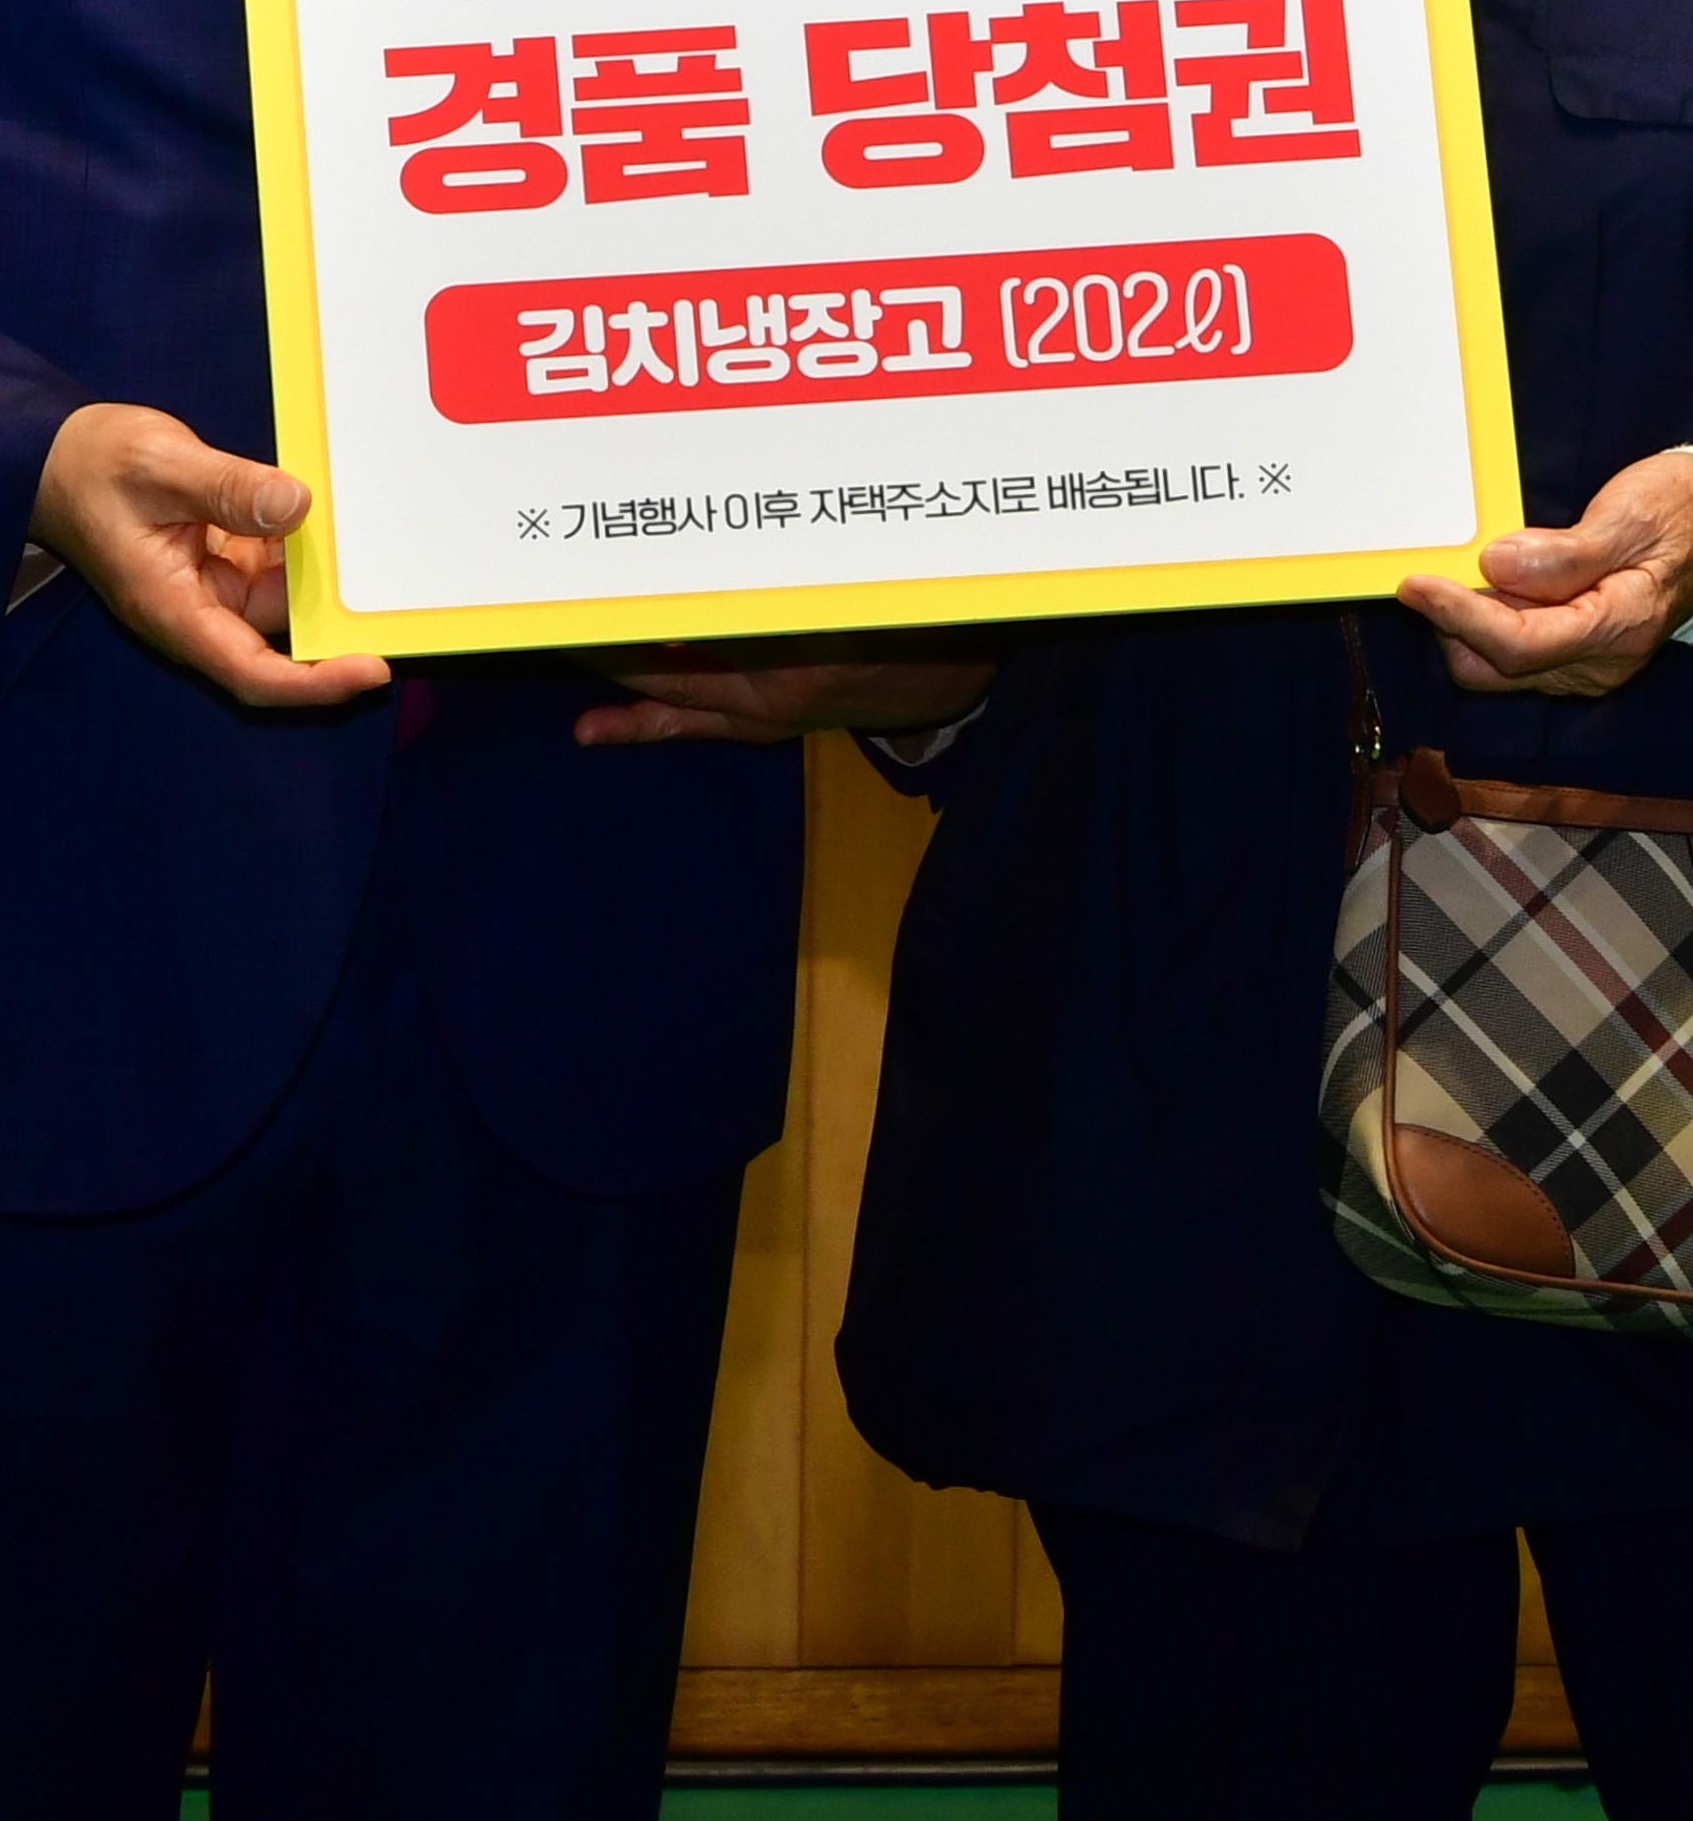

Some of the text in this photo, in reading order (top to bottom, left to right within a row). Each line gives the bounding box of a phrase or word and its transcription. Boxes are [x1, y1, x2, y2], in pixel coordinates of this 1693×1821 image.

[384, 26, 750, 214] 경품
[517, 286, 972, 395] 김치냉장고
[562, 496, 717, 539] 기념행사
[725, 490, 801, 529] 이후
[810, 477, 1039, 524] 자택주소지로
[1048, 464, 1244, 511] 배송됩니다.
